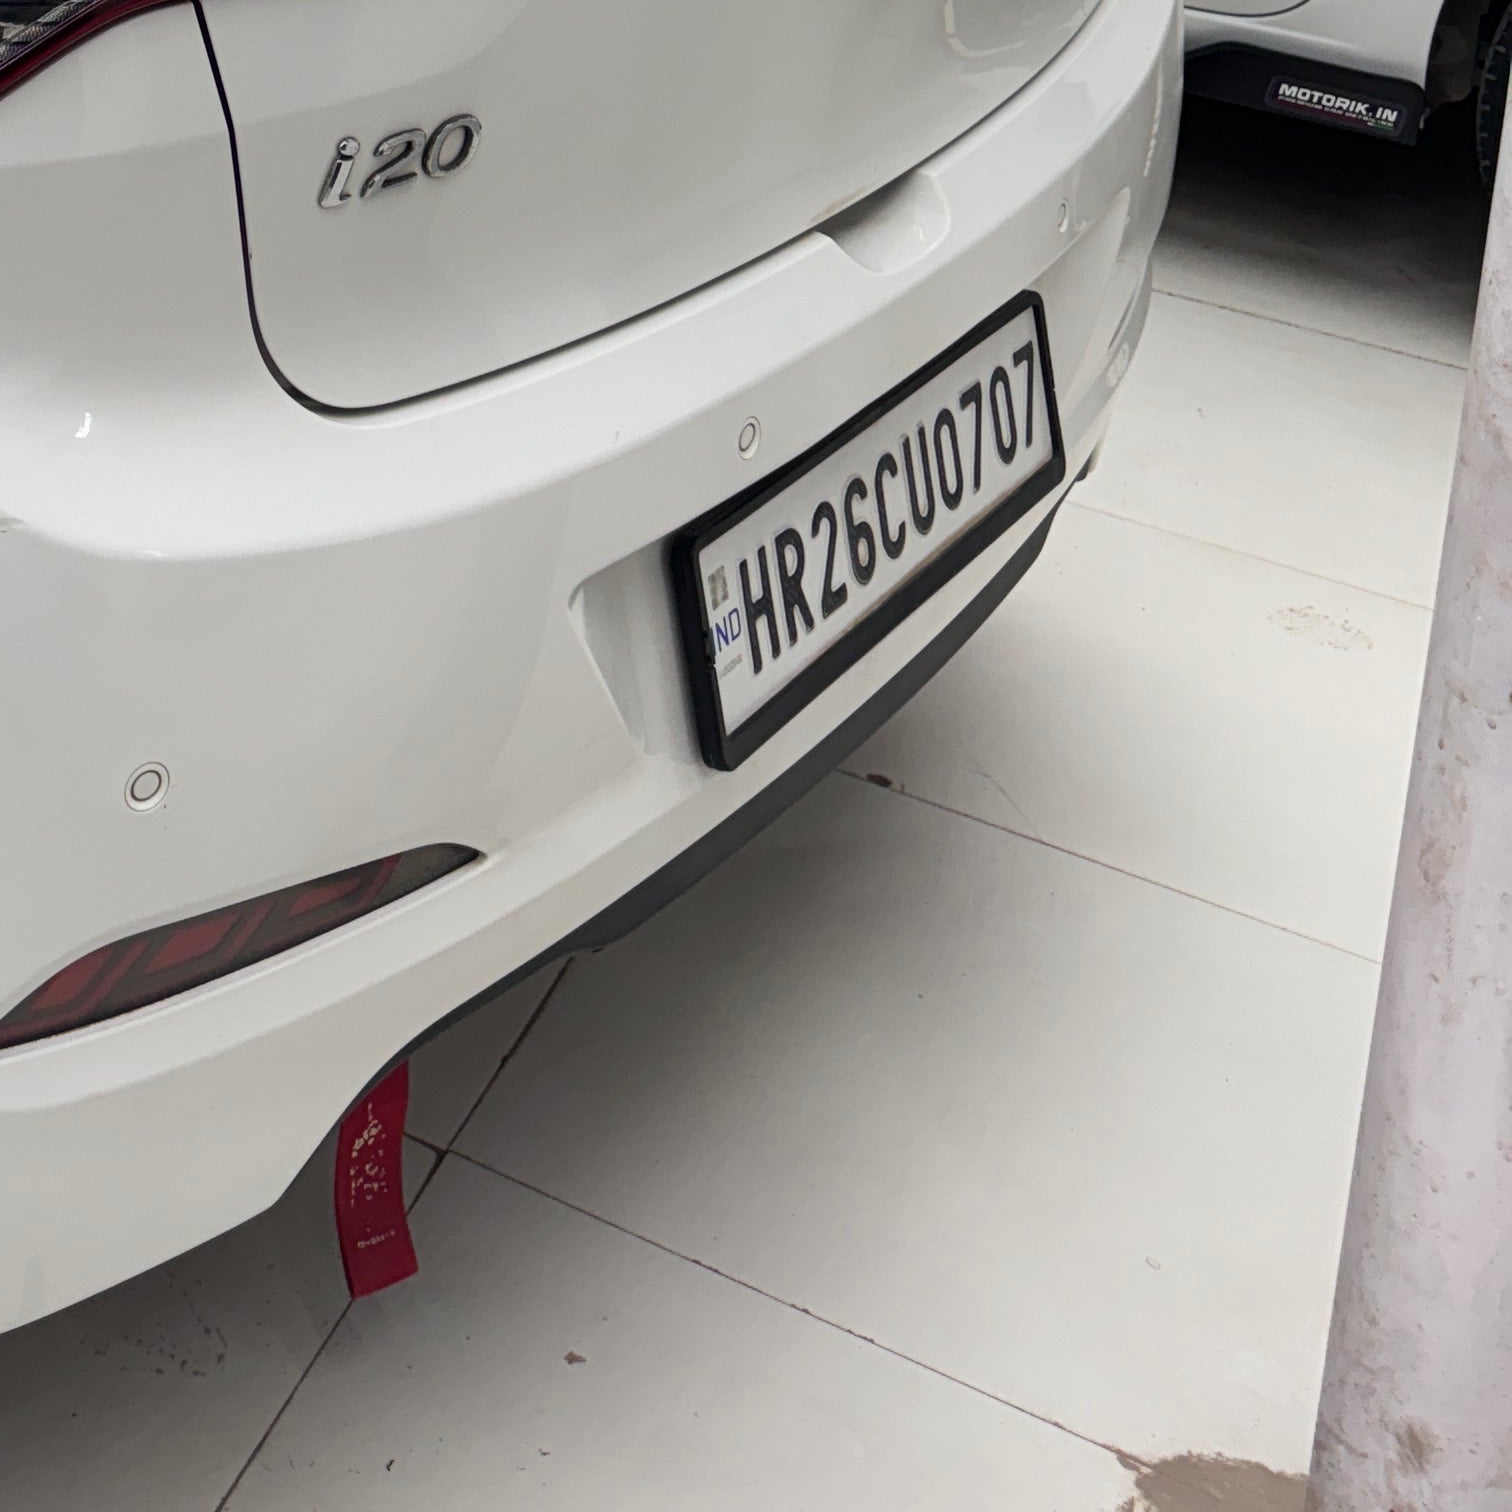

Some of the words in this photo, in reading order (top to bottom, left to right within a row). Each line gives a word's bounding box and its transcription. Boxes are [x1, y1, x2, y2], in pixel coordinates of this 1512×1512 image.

[1277, 82, 1399, 123] MOTORIK.IN
[317, 113, 483, 209] i20
[738, 339, 1035, 676] HR26CU0707
[710, 607, 742, 654] ND
